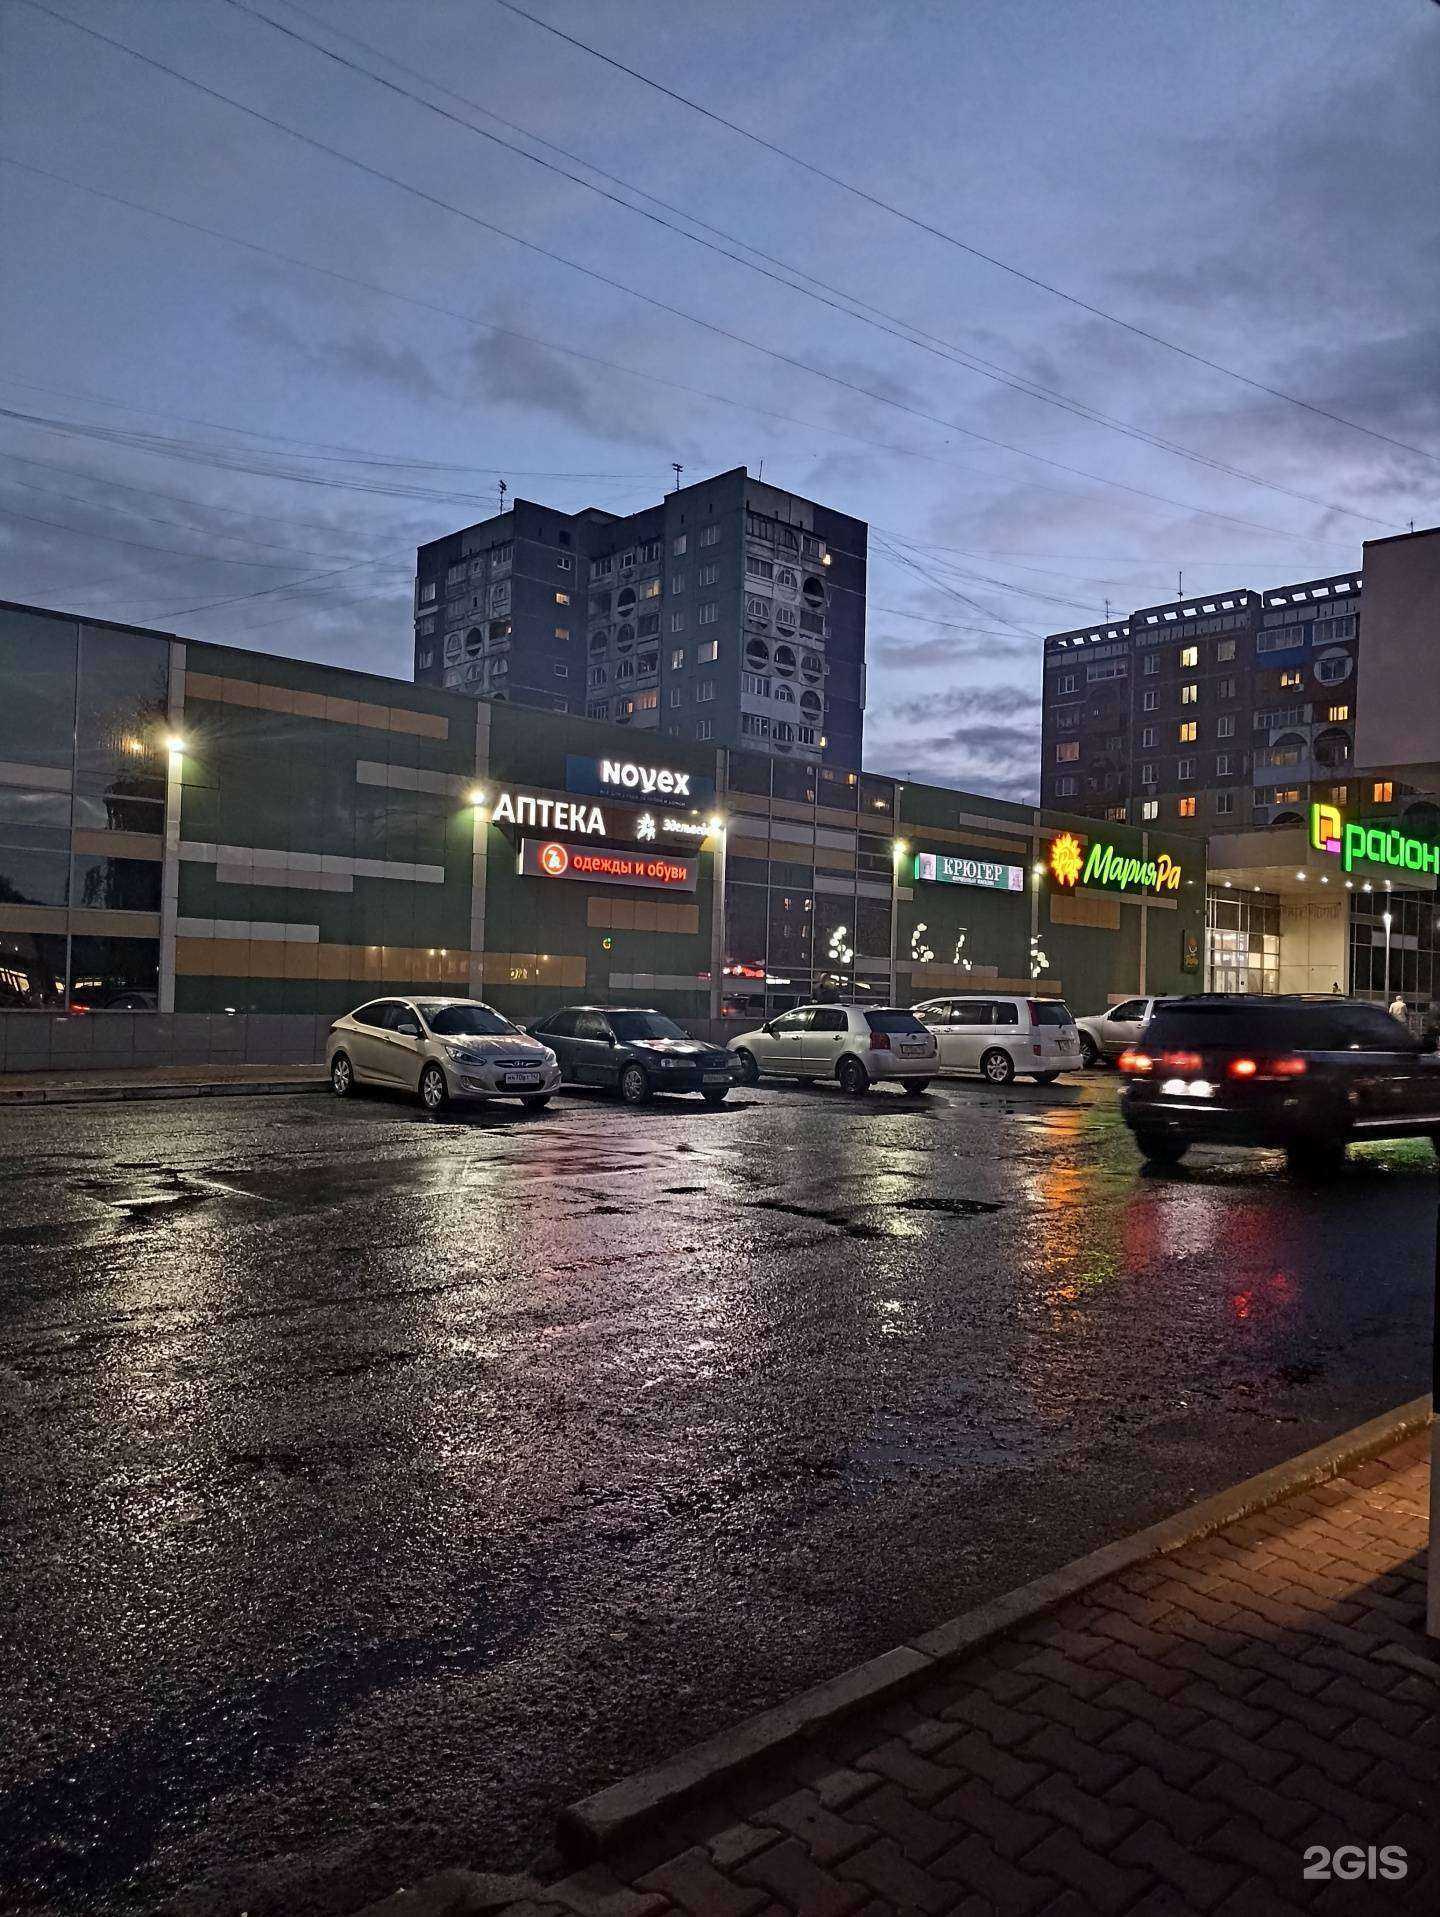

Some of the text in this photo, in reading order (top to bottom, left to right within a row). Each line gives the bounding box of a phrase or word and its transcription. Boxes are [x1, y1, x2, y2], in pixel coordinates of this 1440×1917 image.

[492, 793, 607, 836] АПТЕКА
[1345, 823, 1440, 875] район
[573, 856, 687, 882] одежды и обуви
[943, 857, 1003, 881] КРЮГЕР
